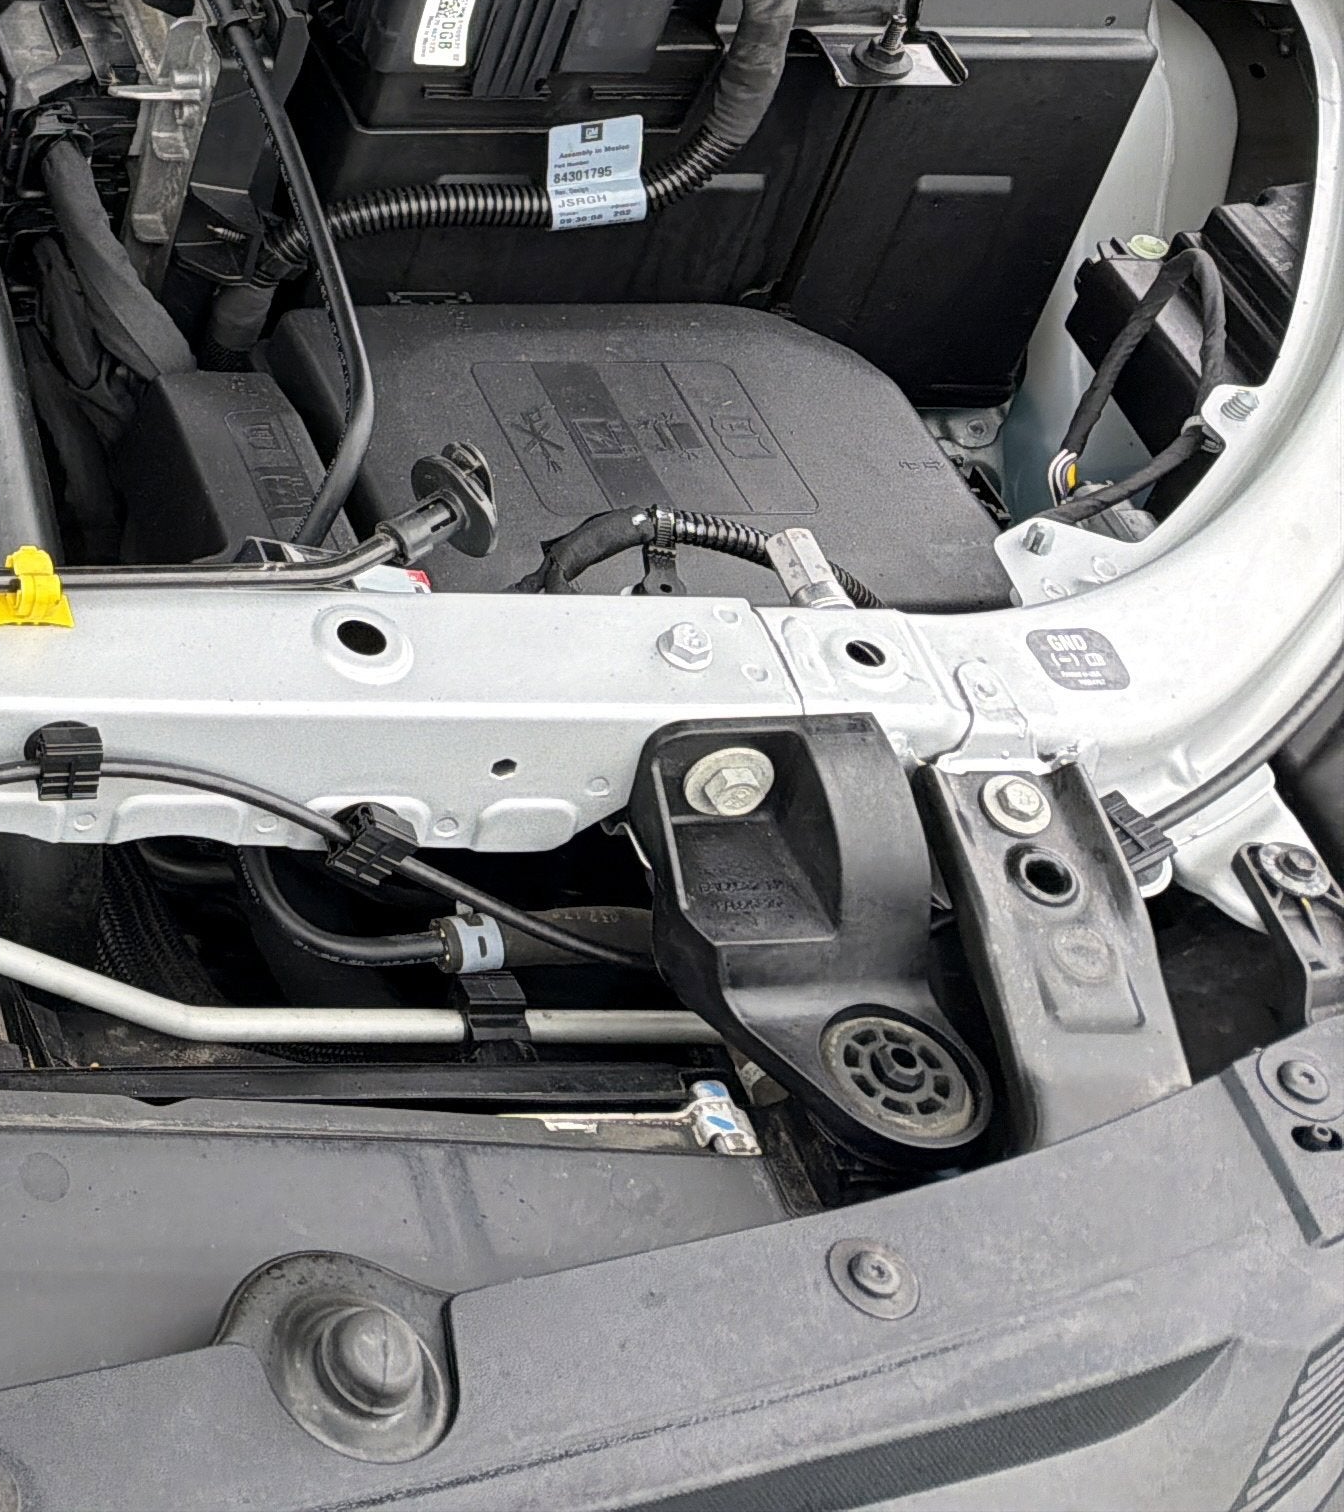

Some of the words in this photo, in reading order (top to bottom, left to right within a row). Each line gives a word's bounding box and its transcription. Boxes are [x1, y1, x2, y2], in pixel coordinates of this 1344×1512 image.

[553, 166, 613, 184] 84301795
[558, 194, 608, 209] JSRGH
[1046, 634, 1088, 652] GND
